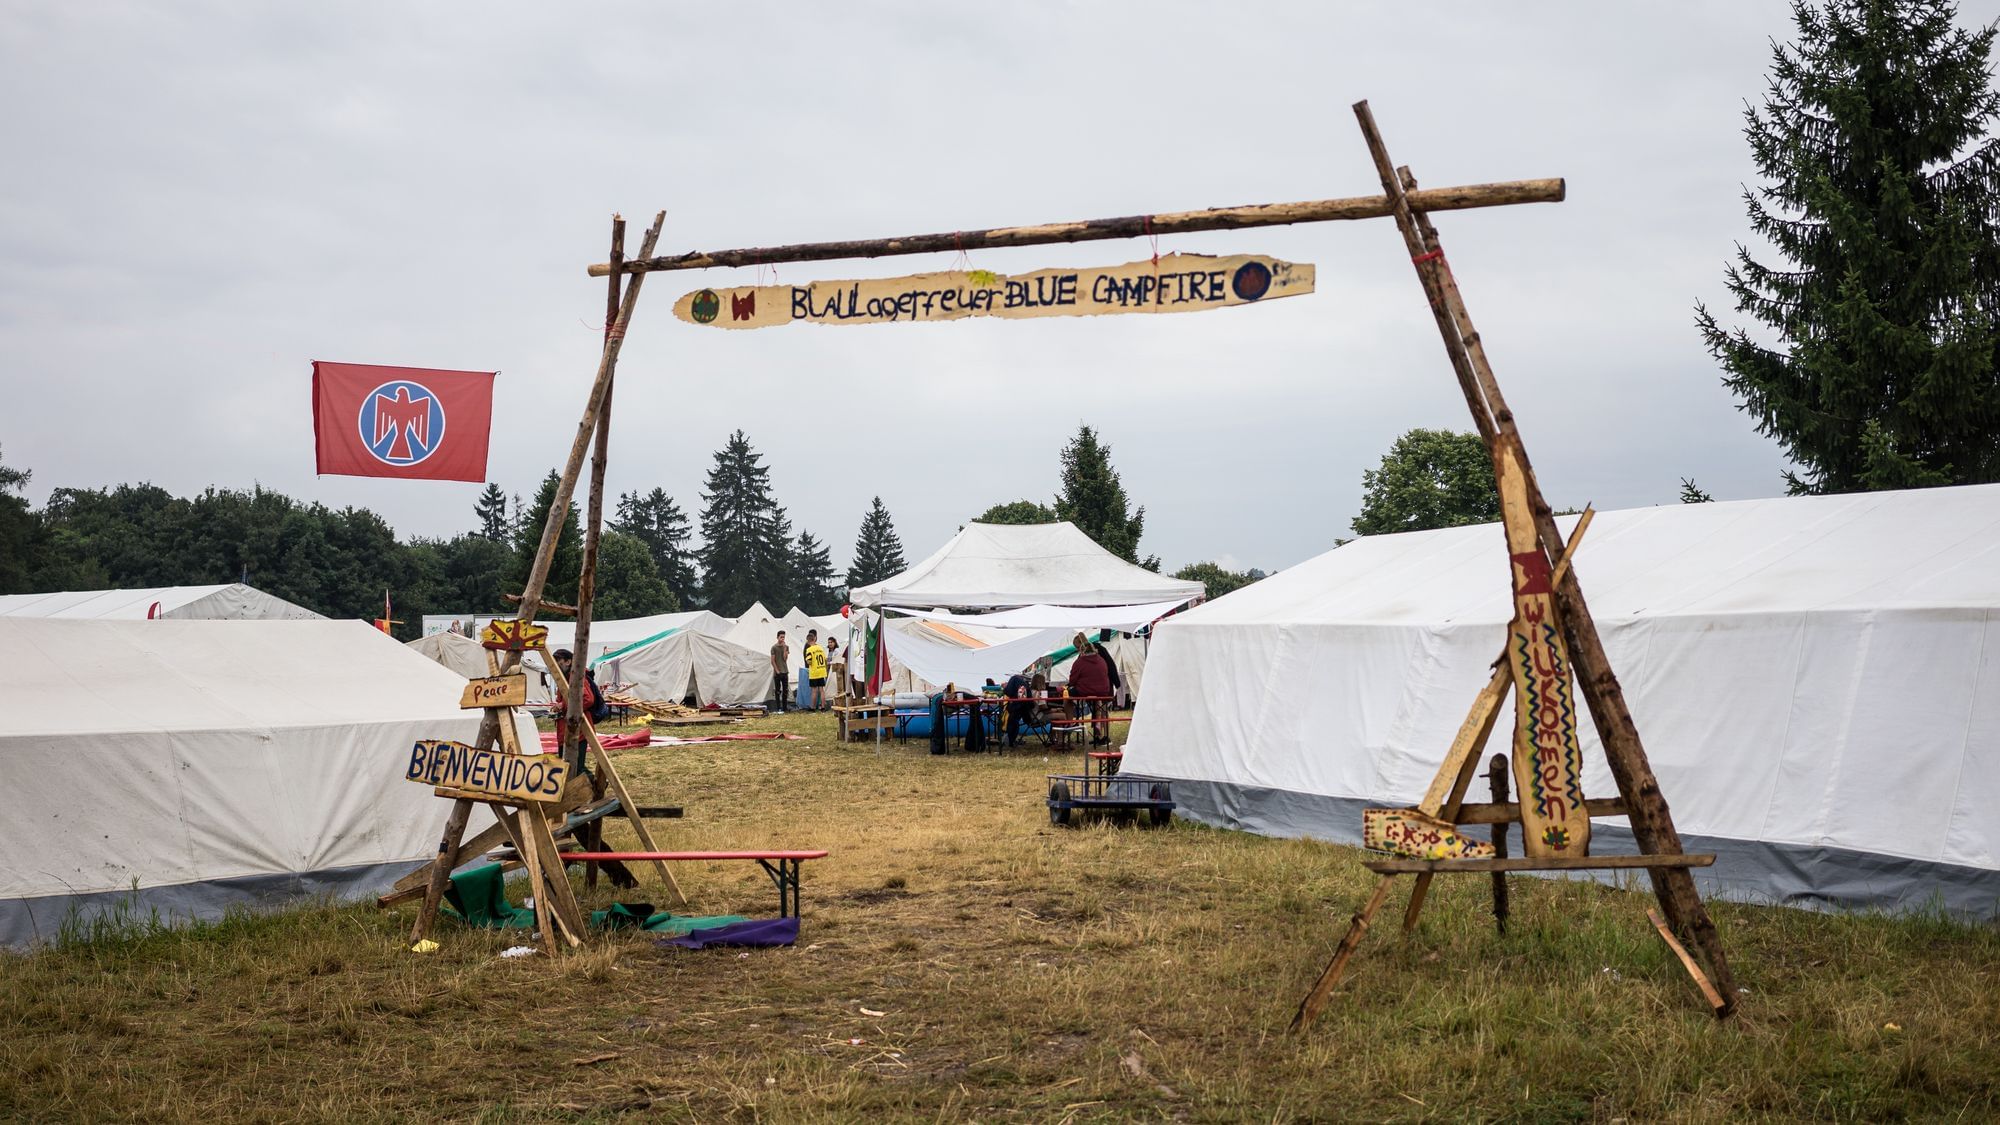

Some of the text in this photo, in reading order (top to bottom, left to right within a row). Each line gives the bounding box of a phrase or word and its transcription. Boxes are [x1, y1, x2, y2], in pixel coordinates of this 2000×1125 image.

[1004, 274, 1078, 308] BLUE
[1093, 271, 1226, 307] CAMPFIRE
[815, 654, 824, 666] 10
[474, 684, 508, 704] Peace
